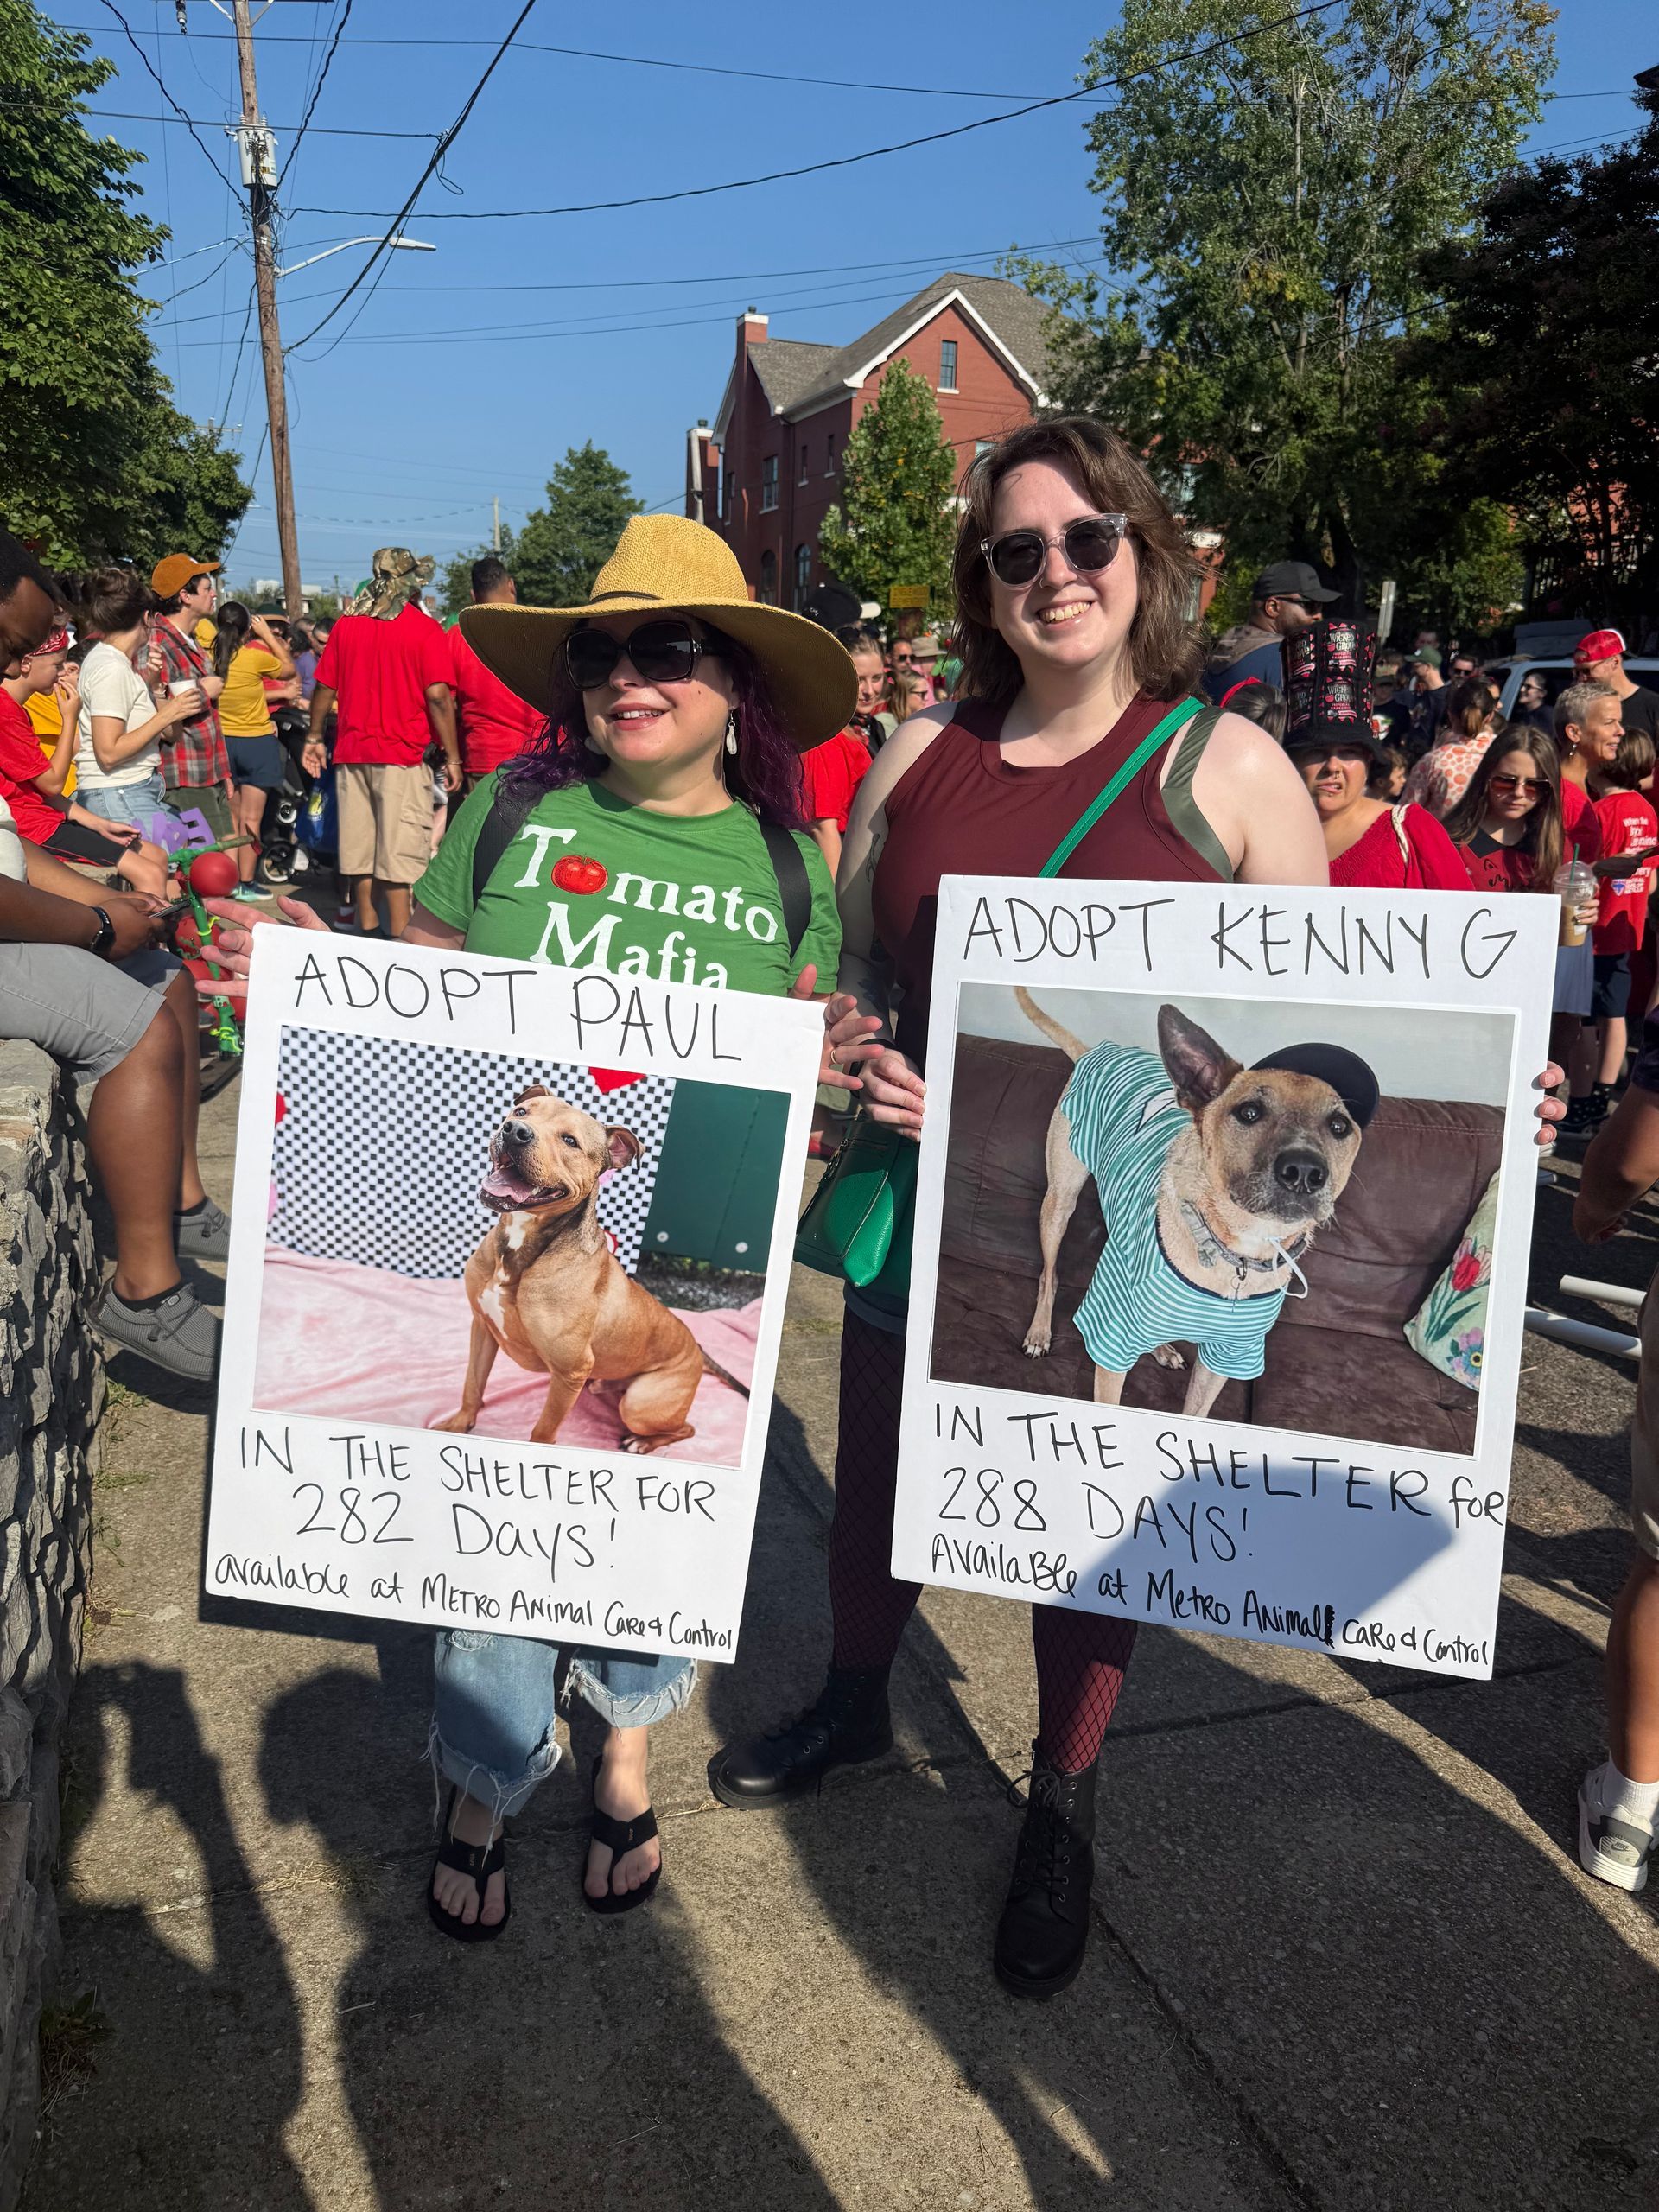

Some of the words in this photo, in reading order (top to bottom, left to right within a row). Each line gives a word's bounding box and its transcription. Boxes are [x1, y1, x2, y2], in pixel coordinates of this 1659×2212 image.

[529, 901, 728, 989] Mafia
[963, 896, 1176, 973] ADOPT
[1211, 901, 1431, 980] KENNY
[1461, 907, 1518, 980] G
[295, 952, 537, 1035] ADOPT
[570, 975, 742, 1062] PAUL
[240, 1426, 294, 1475] IN
[329, 1434, 411, 1482] THE
[440, 1445, 620, 1513] SHELTER
[636, 1476, 715, 1522] FOR
[935, 1402, 984, 1448] IN
[1007, 1411, 1125, 1470] THE
[1155, 1431, 1433, 1516] SHELTER
[292, 1482, 415, 1545] 282
[452, 1503, 617, 1584] Days!
[938, 1466, 1046, 1532] 288
[1081, 1481, 1253, 1564] DAYS!
[371, 1571, 404, 1604] at
[421, 1573, 501, 1618] METRO
[668, 1611, 733, 1650] Control
[1098, 1567, 1129, 1605] at
[1422, 1629, 1490, 1666] Control
